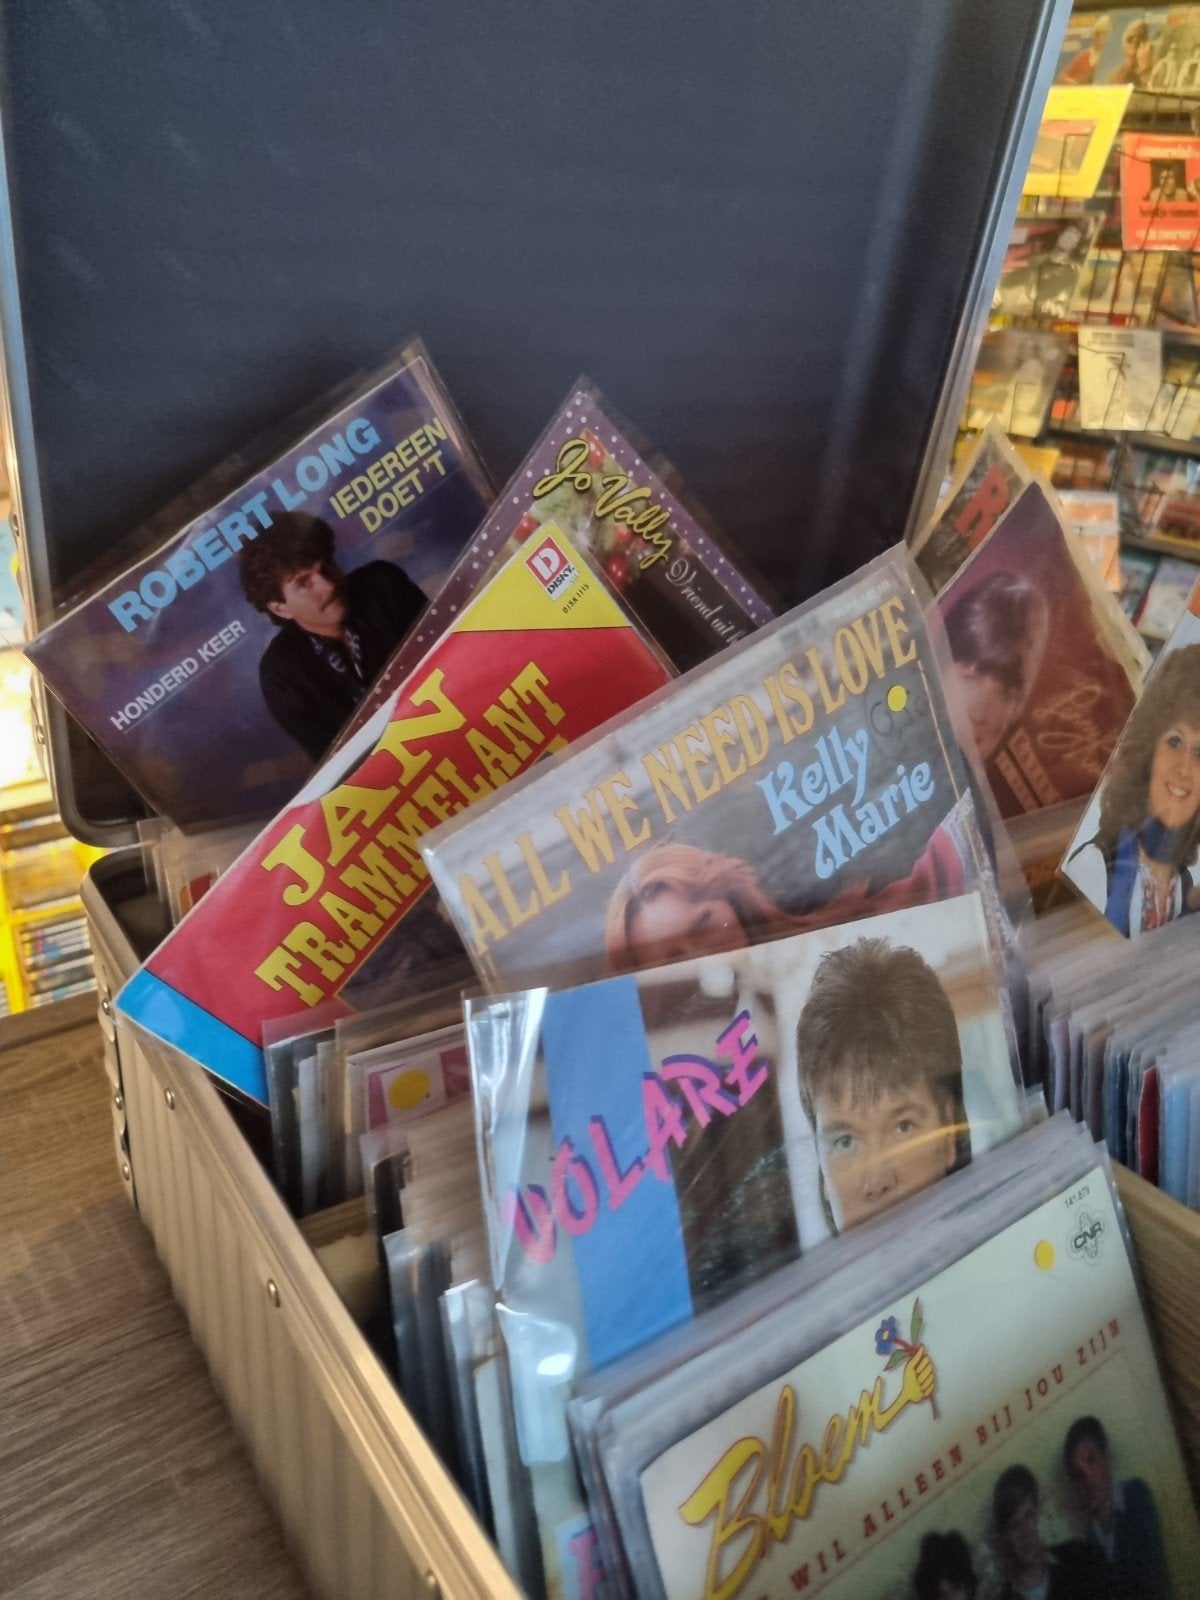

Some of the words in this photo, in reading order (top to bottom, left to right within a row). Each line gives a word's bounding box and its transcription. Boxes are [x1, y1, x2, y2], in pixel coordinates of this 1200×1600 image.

[107, 493, 276, 633] ROBERT
[272, 418, 381, 510] LONG
[330, 418, 447, 519] IEDEREEN
[358, 467, 425, 533] DOET
[533, 438, 591, 497] Jo
[594, 475, 672, 570] Vally
[110, 656, 199, 731] HONDERD
[197, 620, 246, 664] KEER
[254, 661, 566, 1008] TRAMMELANT
[260, 667, 467, 906] JAN
[455, 830, 572, 957] ALL
[555, 771, 652, 877] WE
[641, 694, 771, 825] NEED
[763, 663, 815, 745] IS
[806, 596, 918, 716] LOVE
[756, 726, 869, 835] Kelly
[812, 760, 935, 879] Marie
[678, 1385, 905, 1600] Bloem
[790, 1540, 846, 1591] WIL
[863, 1445, 964, 1538] ALLEEN
[976, 1404, 1012, 1446] BIJ
[1024, 1364, 1064, 1411] JOU
[1077, 1318, 1121, 1366] ZIJN
